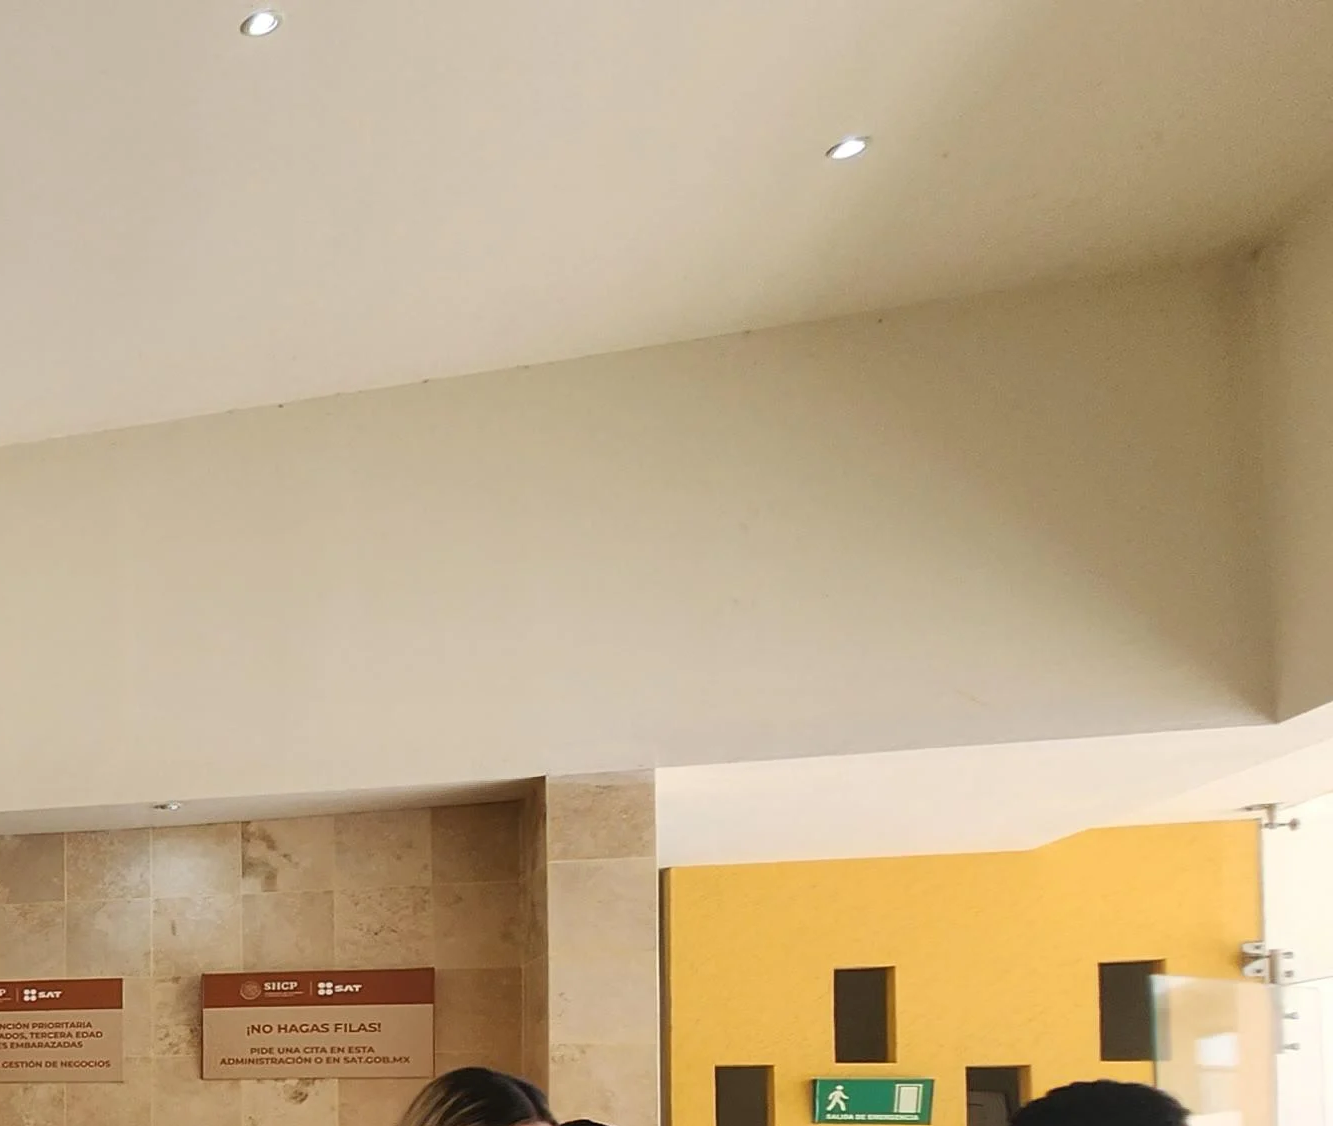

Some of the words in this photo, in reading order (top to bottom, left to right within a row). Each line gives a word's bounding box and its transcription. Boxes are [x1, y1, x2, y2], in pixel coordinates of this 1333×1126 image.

[334, 984, 363, 993] SAT
[38, 990, 62, 999] SAT
[31, 1021, 93, 1030] PRIORITARIA
[246, 1023, 273, 1037] ¡NO
[277, 1022, 330, 1034] HAGAS
[334, 1021, 382, 1033] FILAS!
[30, 1031, 73, 1039] TERCERA
[75, 1030, 104, 1039] EDAD
[10, 1040, 84, 1049] EMBARAZADAS
[250, 1046, 275, 1055] PIDE
[277, 1046, 301, 1054] UNA
[302, 1045, 328, 1054] CITA
[330, 1045, 345, 1054] EN
[348, 1045, 376, 1054] ESTA
[45, 1060, 58, 1068] DE
[60, 1059, 112, 1068] NEGOCIOS
[314, 1056, 324, 1065] O
[325, 1055, 341, 1064] EN
